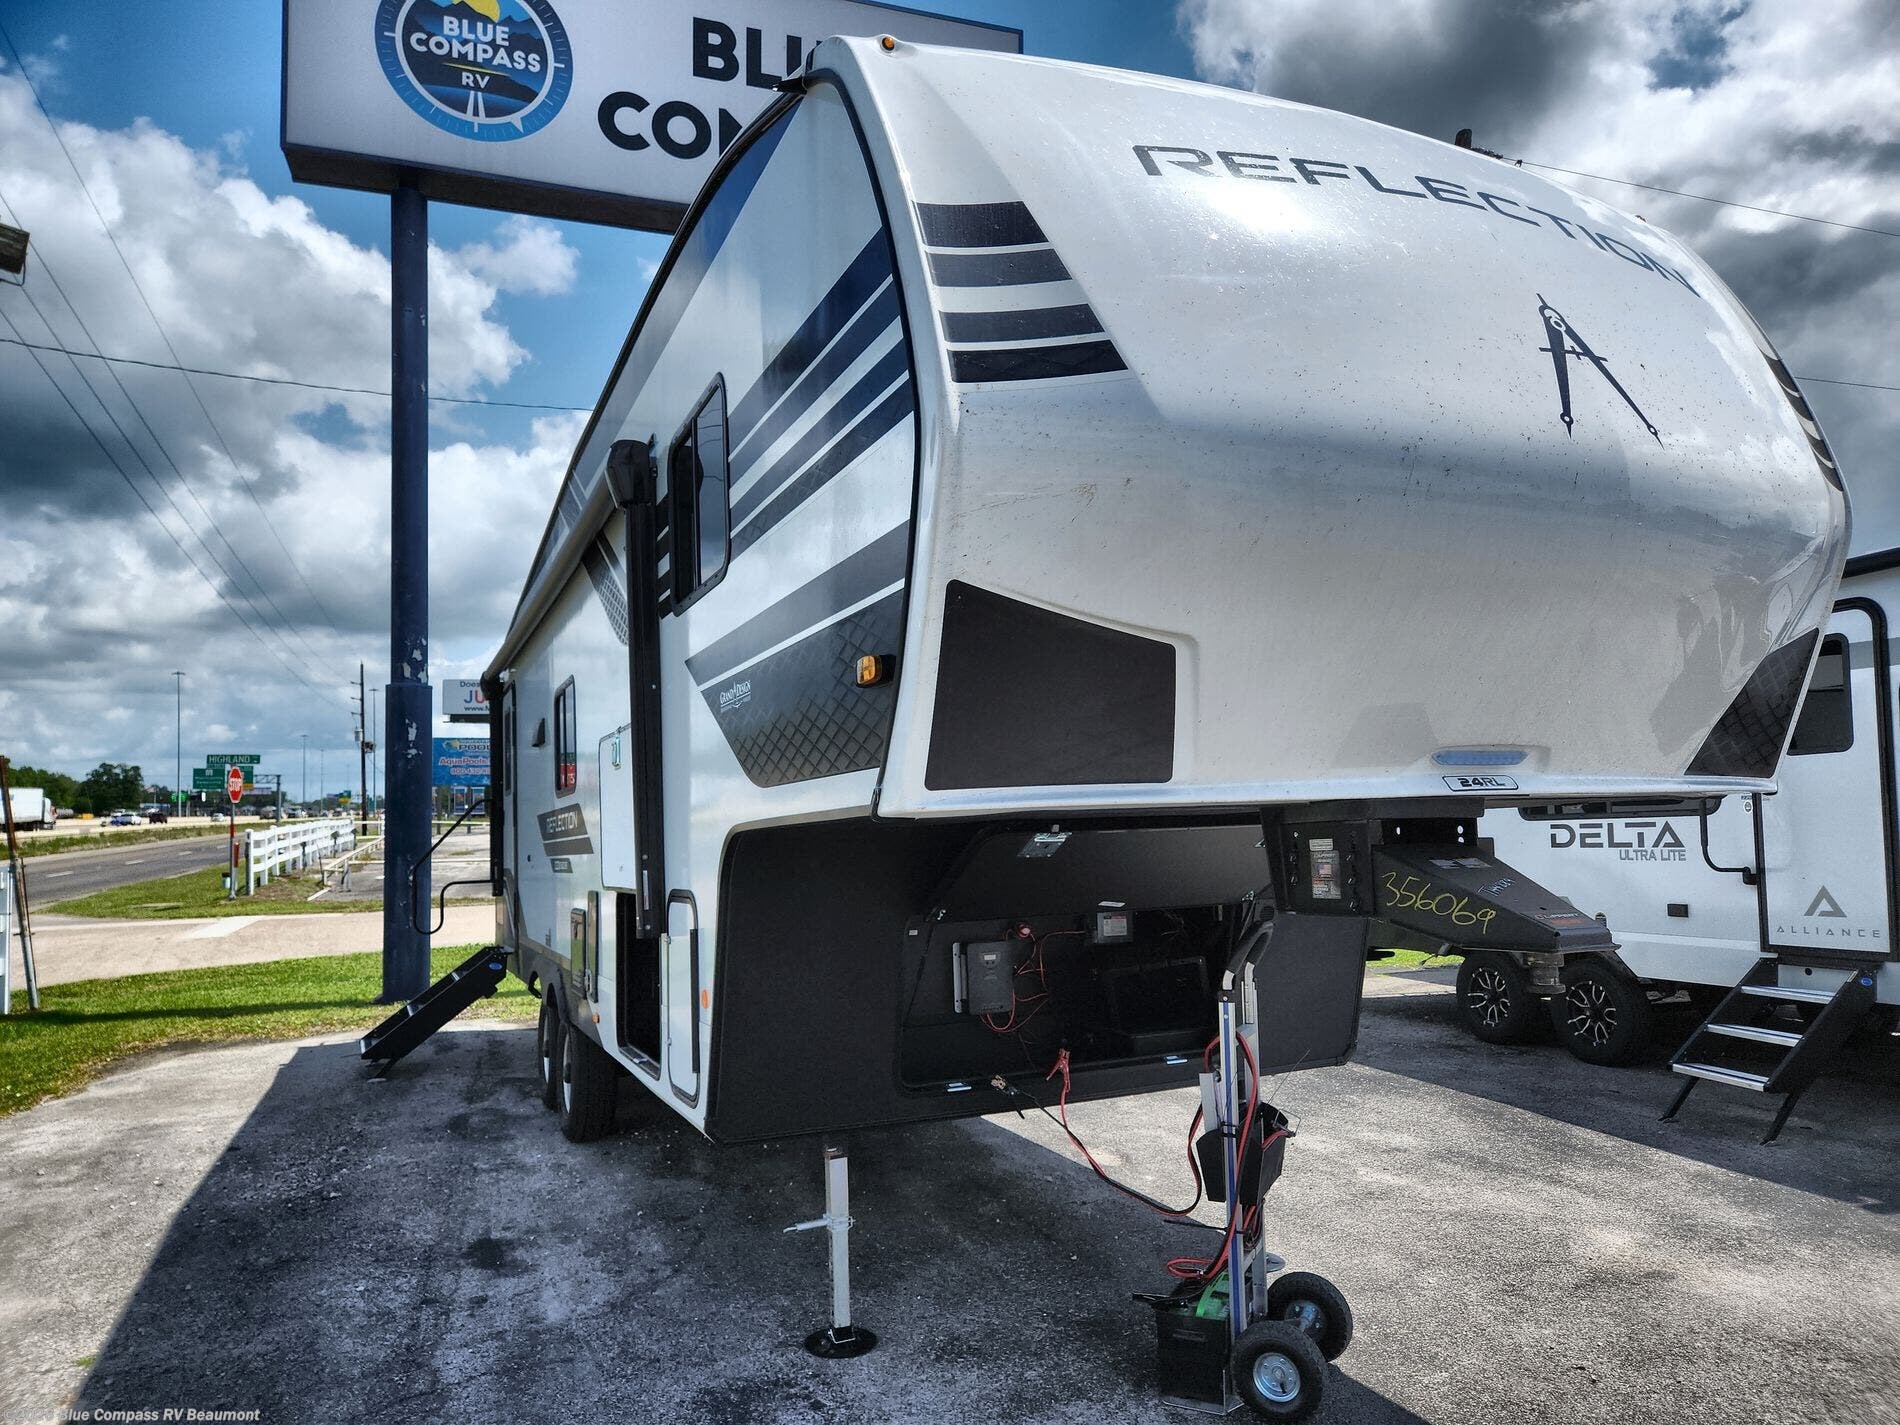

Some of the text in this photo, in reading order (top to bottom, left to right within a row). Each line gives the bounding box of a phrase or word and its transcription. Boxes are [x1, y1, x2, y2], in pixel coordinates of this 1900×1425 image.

[443, 16, 510, 47] BLUE
[409, 32, 541, 73] COMPASS
[461, 72, 490, 89] RV
[1132, 144, 1701, 298] REFLECTION
[208, 755, 250, 764] HIGHLAND
[229, 777, 242, 792] STOP
[1457, 777, 1506, 788] 24RL
[1550, 820, 1686, 849] DELTA
[1619, 849, 1687, 862] ULTRA LITE
[1381, 871, 1497, 935] 356069
[1776, 925, 1881, 938] ALLIANCE
